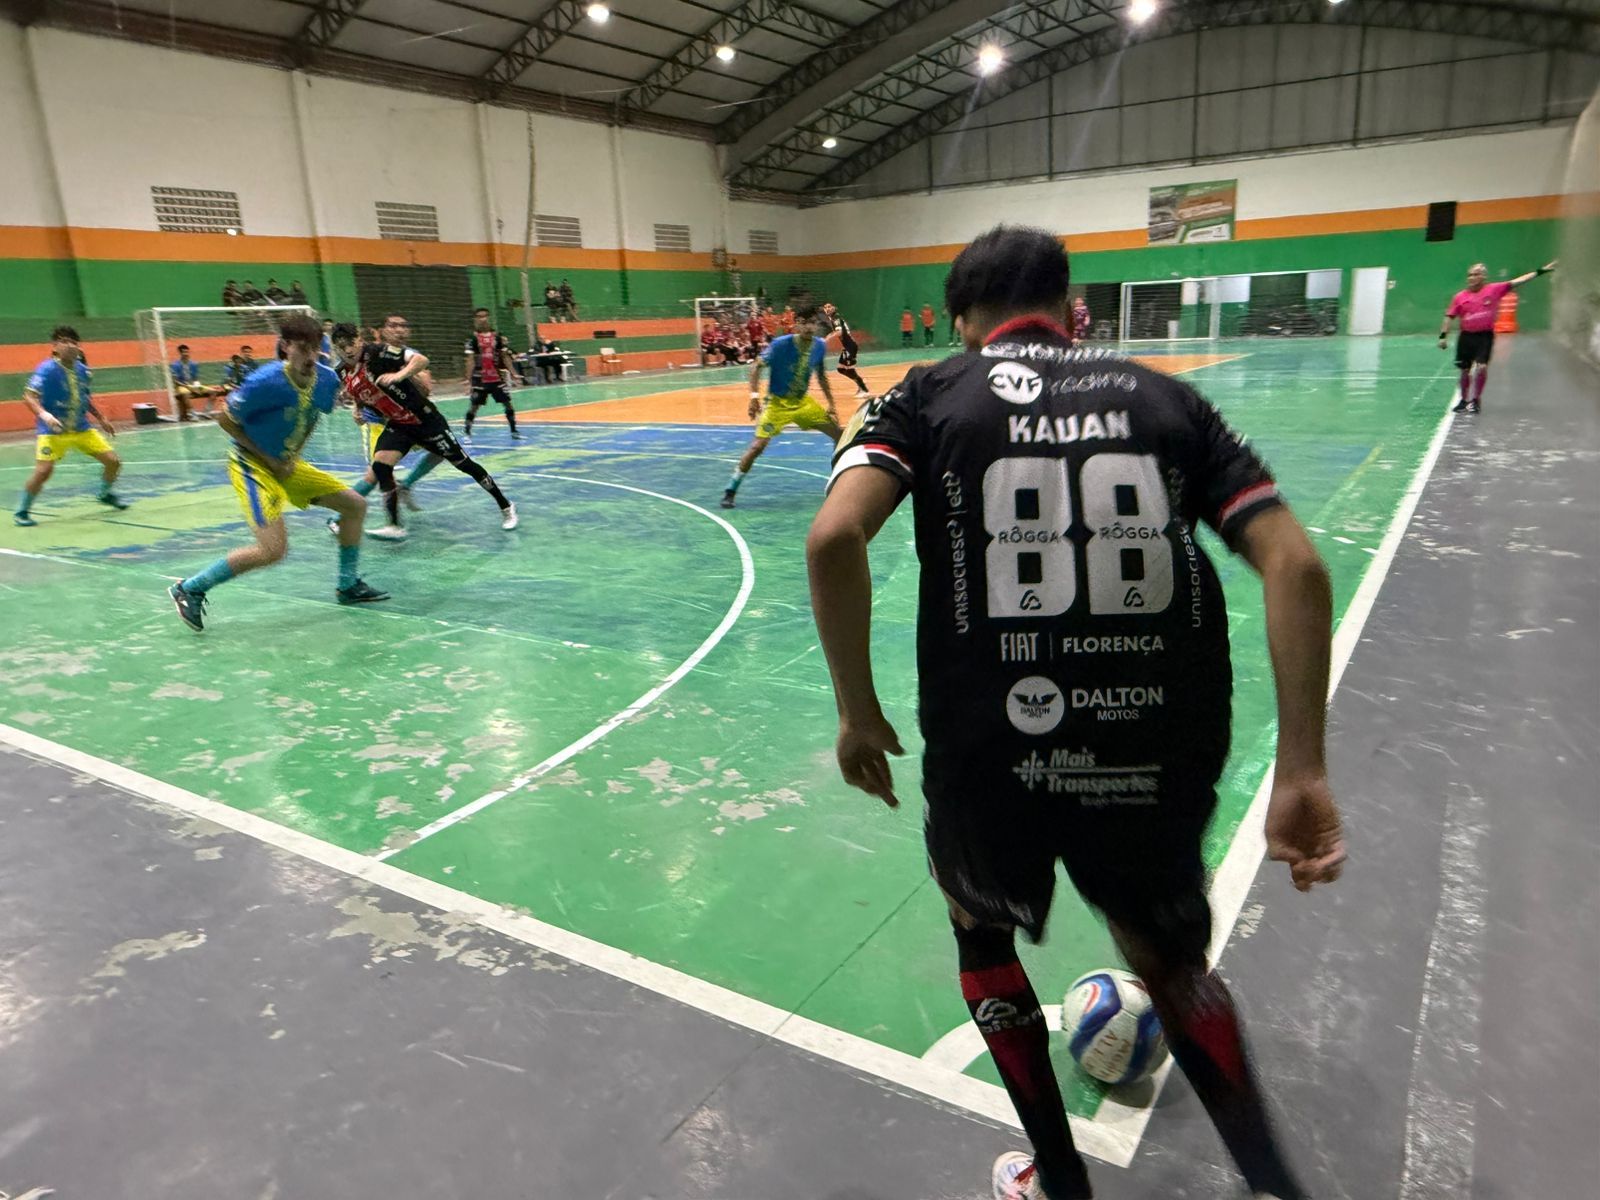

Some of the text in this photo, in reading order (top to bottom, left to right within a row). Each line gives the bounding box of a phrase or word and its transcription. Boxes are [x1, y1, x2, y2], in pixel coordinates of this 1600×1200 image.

[988, 373, 1042, 393] CVF
[1008, 410, 1131, 444] KAUAN
[982, 453, 1175, 618] 88
[998, 526, 1061, 544] RÔGGA
[1100, 522, 1162, 540] RÔGGA
[1000, 632, 1165, 662] FIAT FLORENÇA
[1071, 686, 1164, 708] DALTON
[1096, 709, 1140, 721] MOTOS
[1050, 747, 1096, 768] Mais
